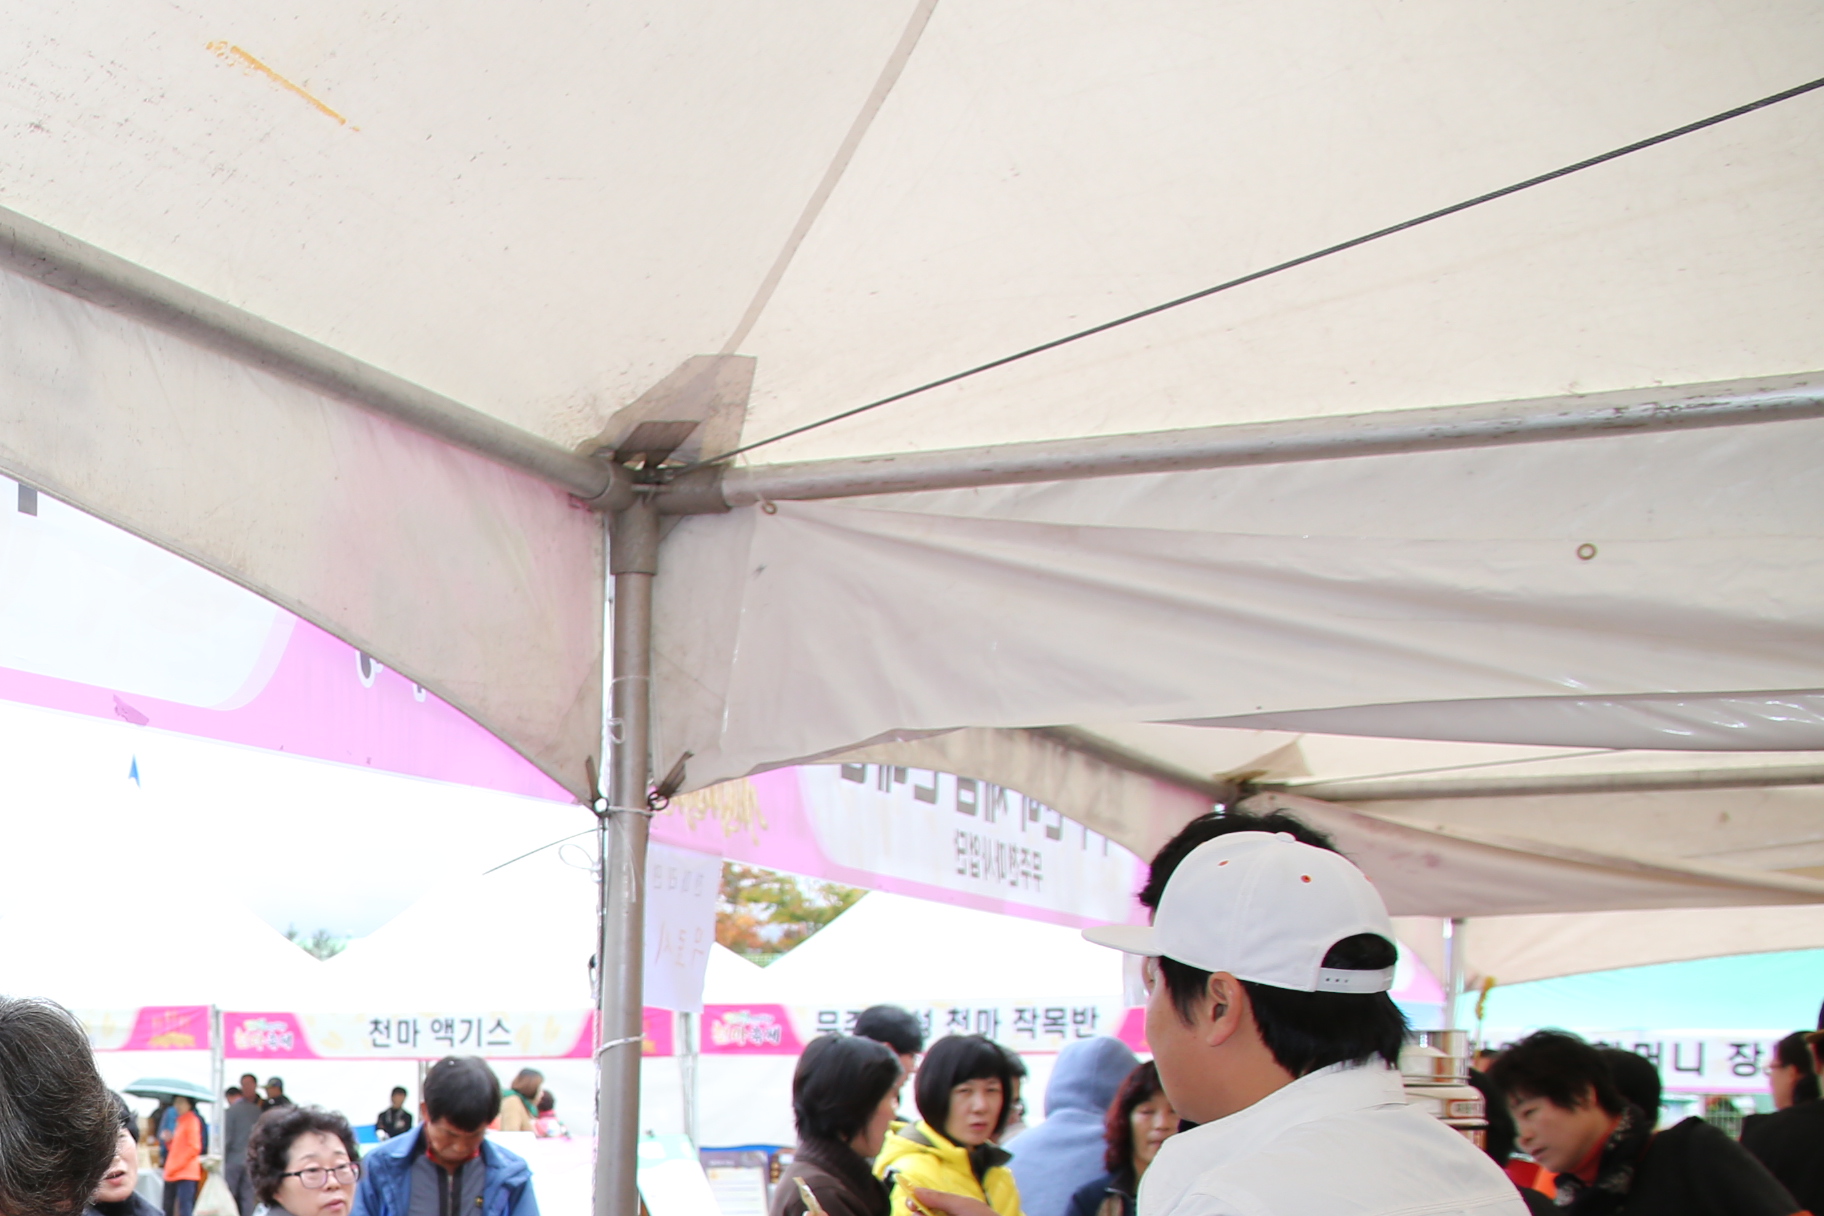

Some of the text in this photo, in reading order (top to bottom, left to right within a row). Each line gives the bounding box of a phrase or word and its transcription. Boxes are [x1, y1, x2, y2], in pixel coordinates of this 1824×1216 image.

[369, 1018, 512, 1049] 천마 액기스
[1013, 1007, 1099, 1039] 작목반
